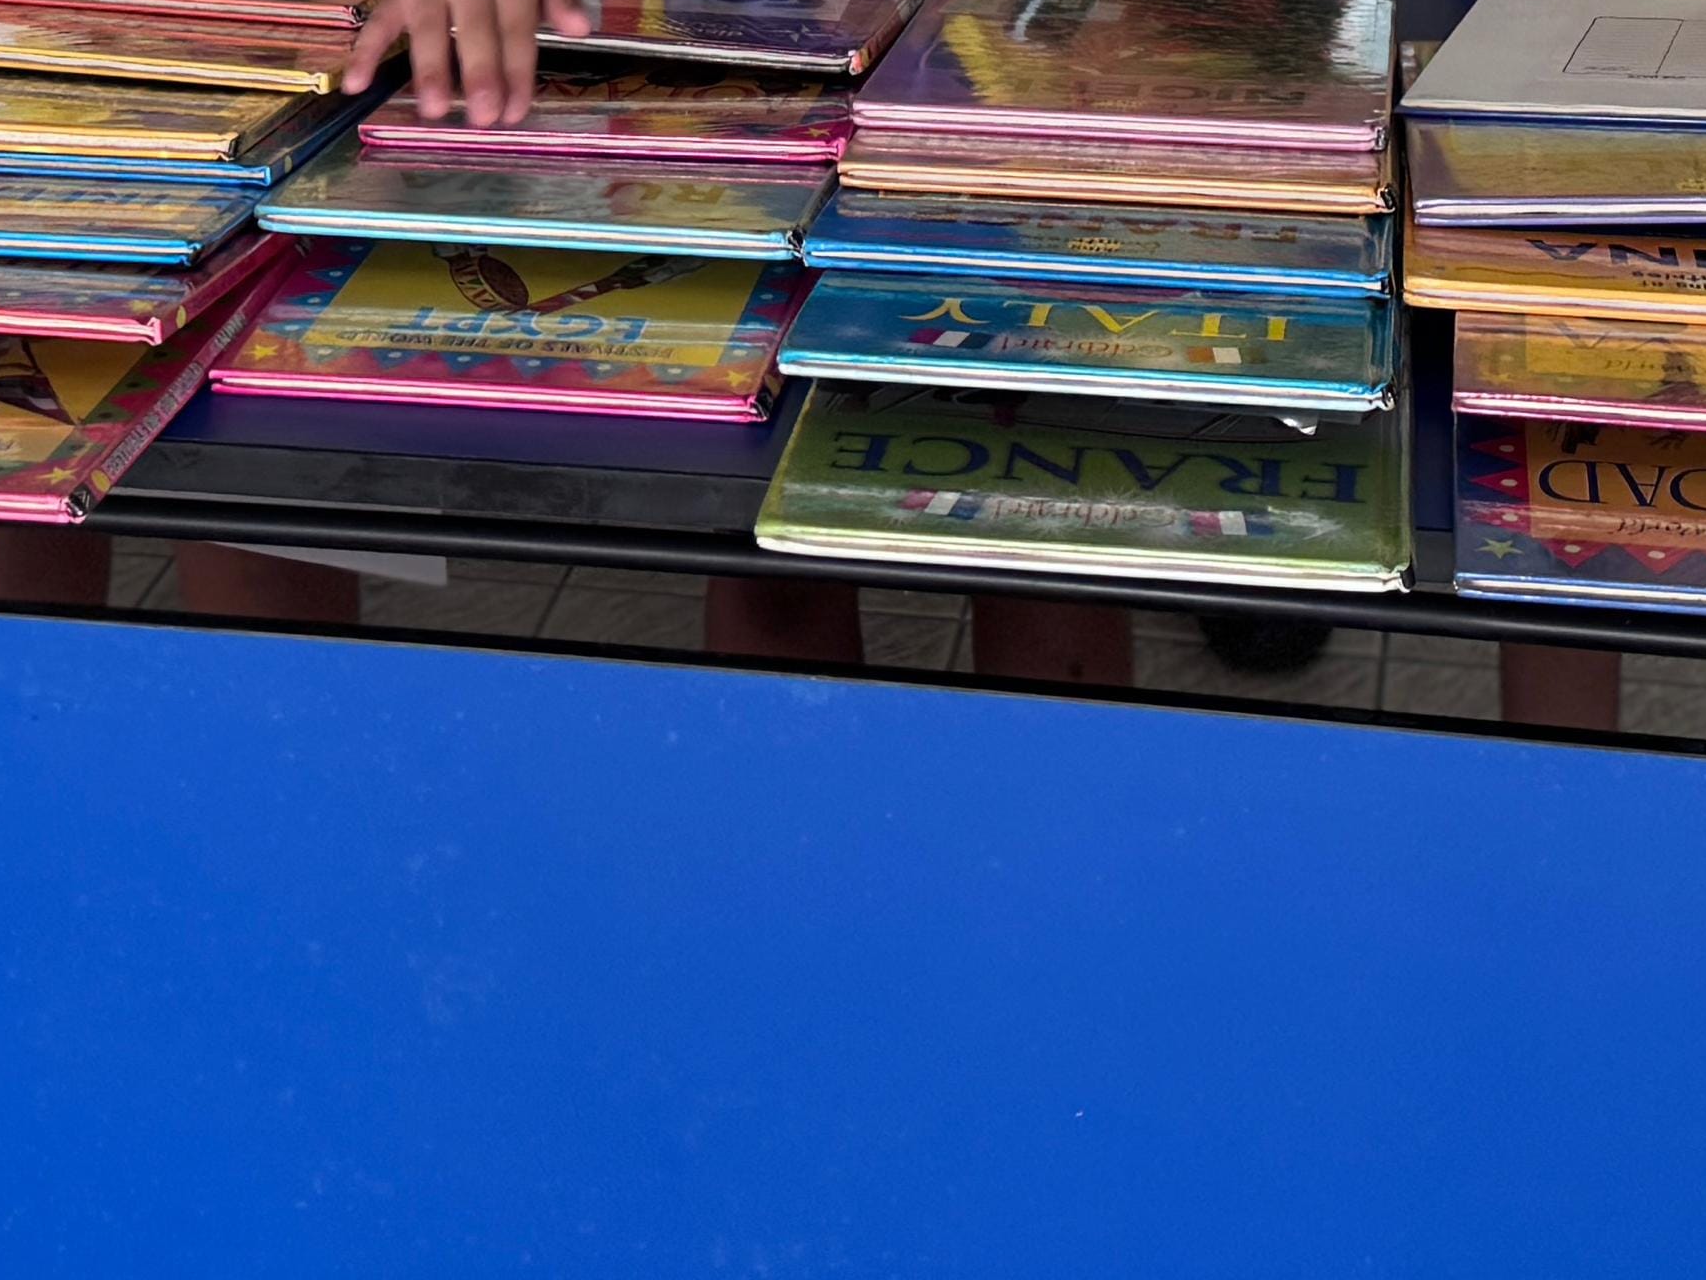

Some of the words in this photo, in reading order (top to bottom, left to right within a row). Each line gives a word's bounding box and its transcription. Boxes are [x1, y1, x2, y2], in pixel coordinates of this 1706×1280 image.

[333, 327, 434, 346] WORLD
[386, 306, 648, 344] EGYPT
[898, 297, 1289, 342] ITALY
[542, 337, 676, 361] FESTIVALS
[833, 430, 1368, 504] FRANCE
